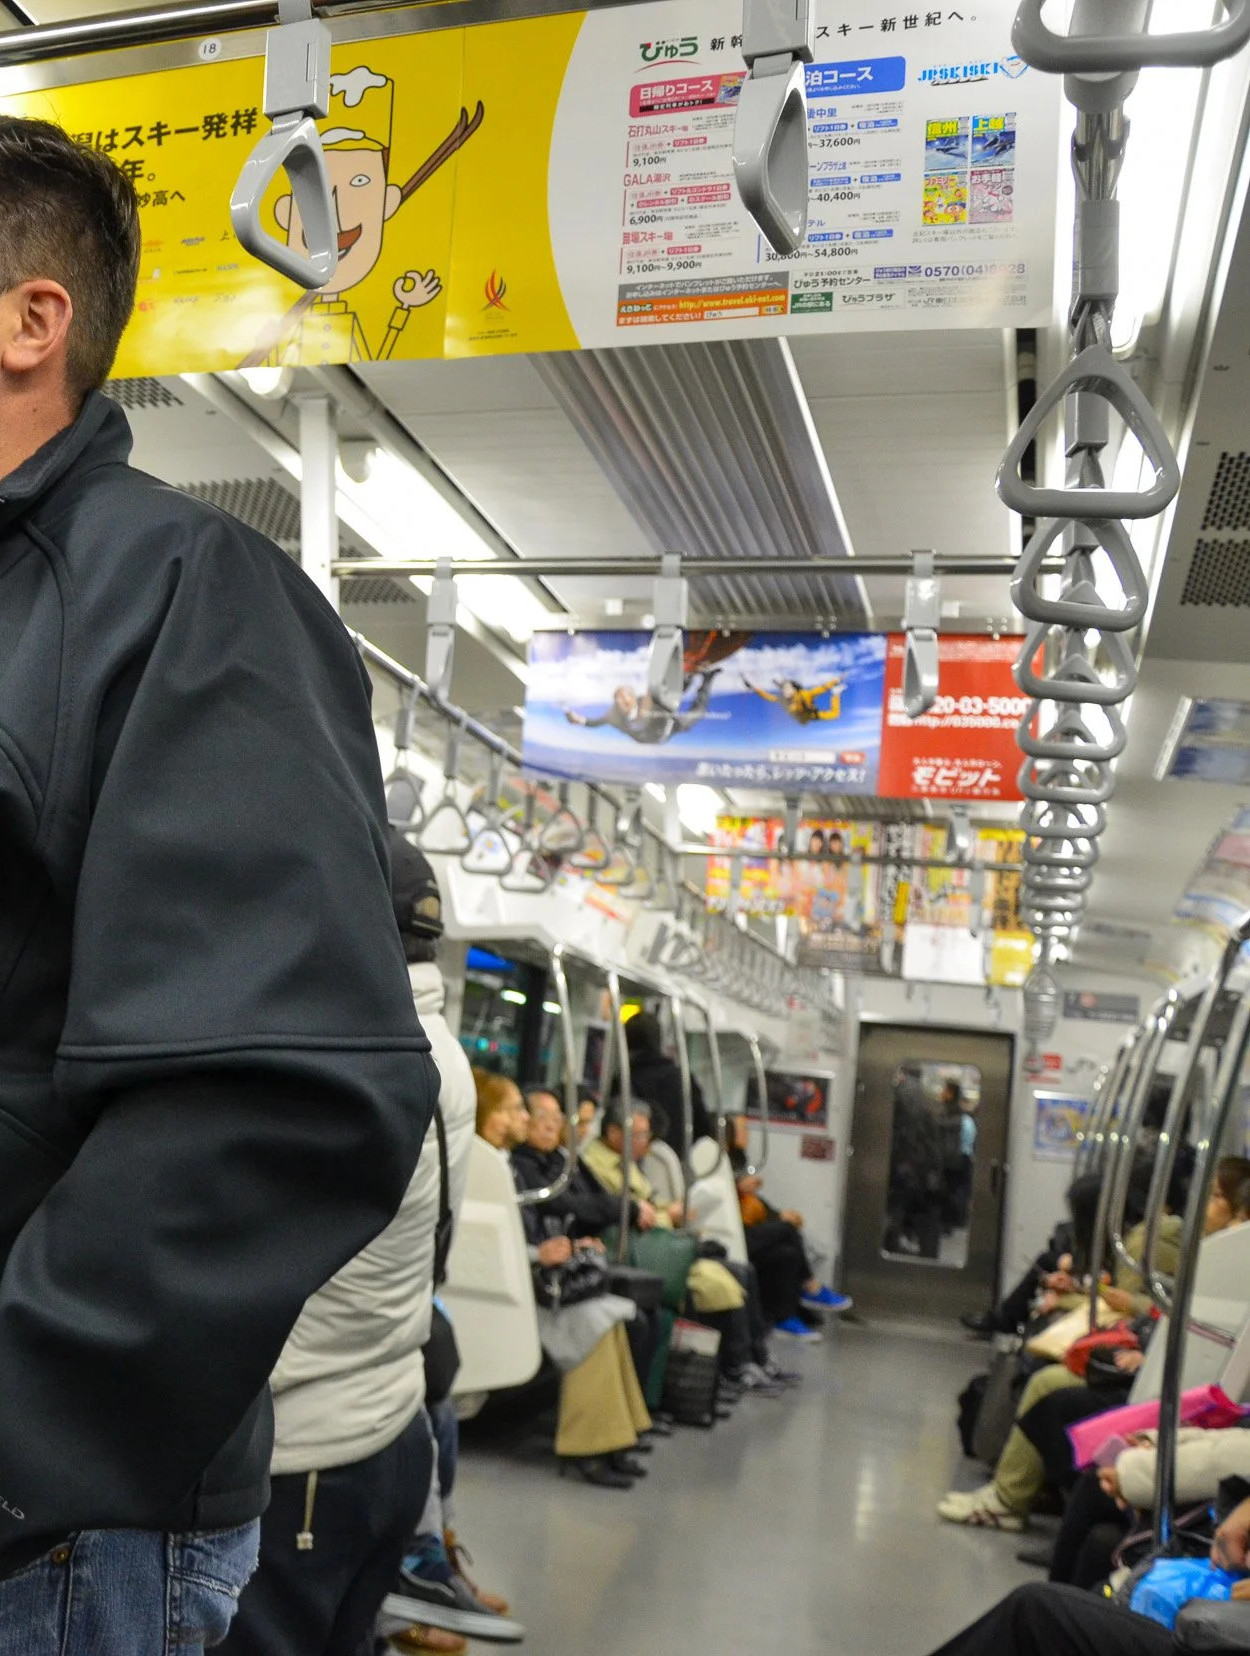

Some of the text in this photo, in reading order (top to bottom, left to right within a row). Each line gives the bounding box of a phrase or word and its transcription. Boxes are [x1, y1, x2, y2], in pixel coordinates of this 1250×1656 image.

[816, 11, 978, 39] スキー新世紀へ。
[203, 43, 216, 54] 18
[639, 36, 699, 62] びゅう
[639, 79, 714, 99] 日帰りコース
[912, 766, 1002, 788] モビット
